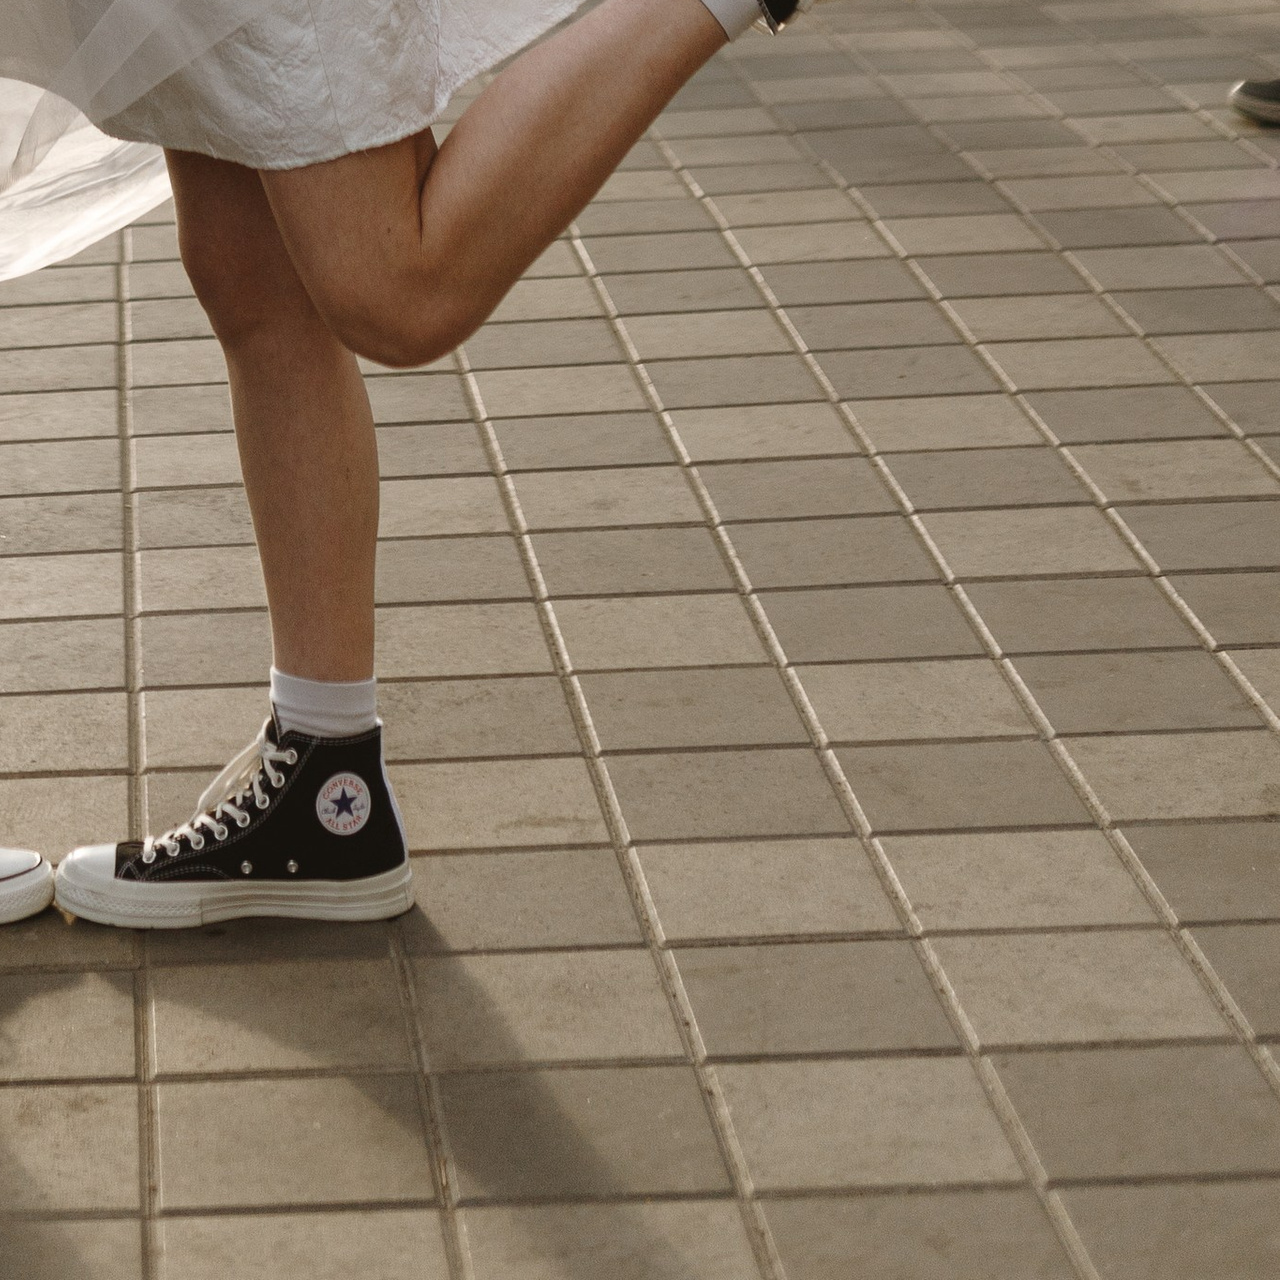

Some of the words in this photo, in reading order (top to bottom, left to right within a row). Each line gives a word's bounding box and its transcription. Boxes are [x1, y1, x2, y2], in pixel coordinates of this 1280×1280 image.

[323, 778, 363, 800] CONVERSE
[325, 817, 340, 830] ALL
[343, 815, 362, 830] STAR
